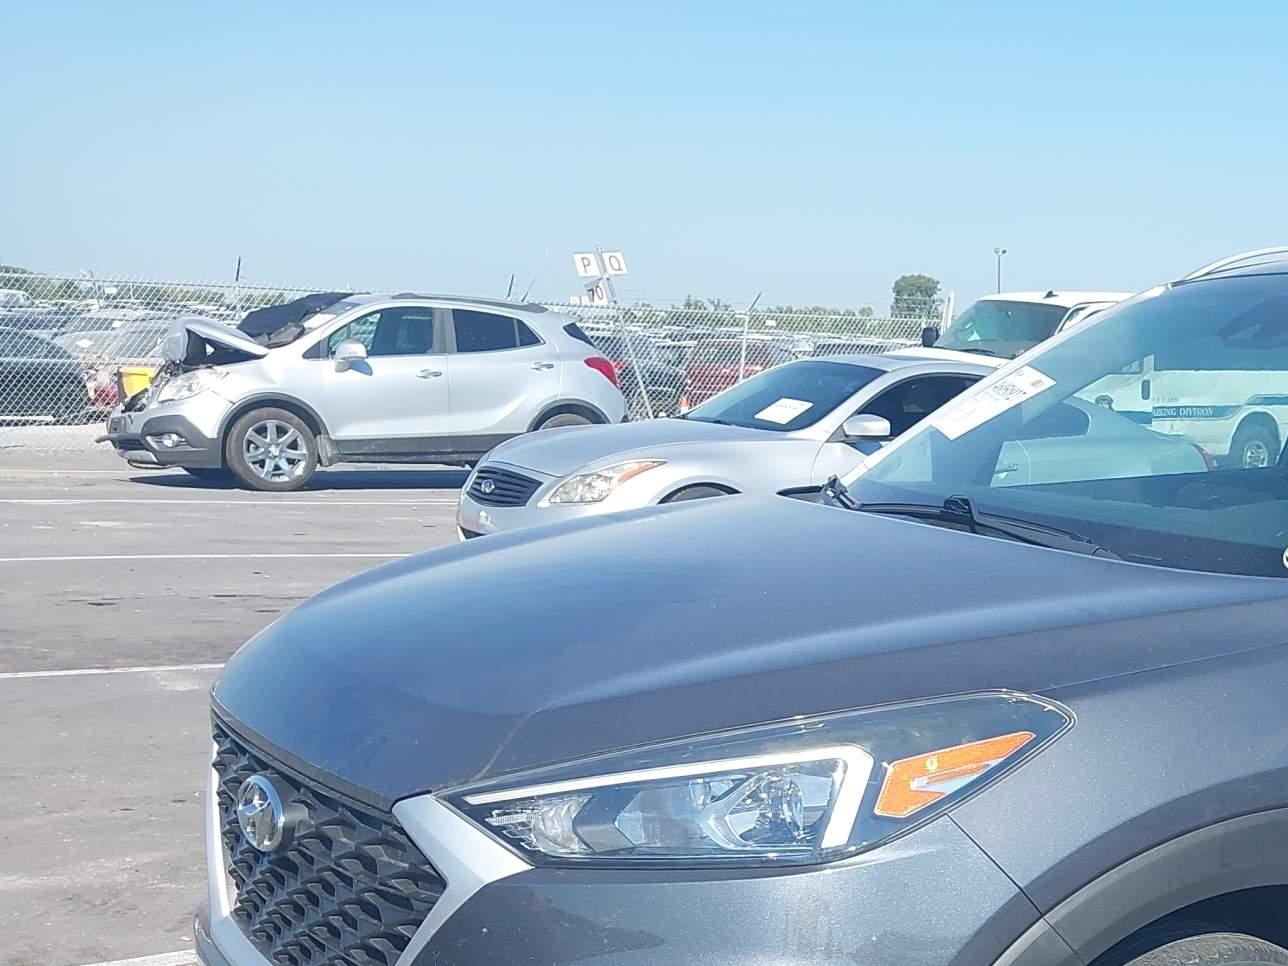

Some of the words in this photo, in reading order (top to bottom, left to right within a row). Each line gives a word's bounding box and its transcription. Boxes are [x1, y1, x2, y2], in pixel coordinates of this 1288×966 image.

[580, 256, 591, 274] P
[608, 255, 623, 272] Q
[1179, 407, 1214, 417] DIVISION
